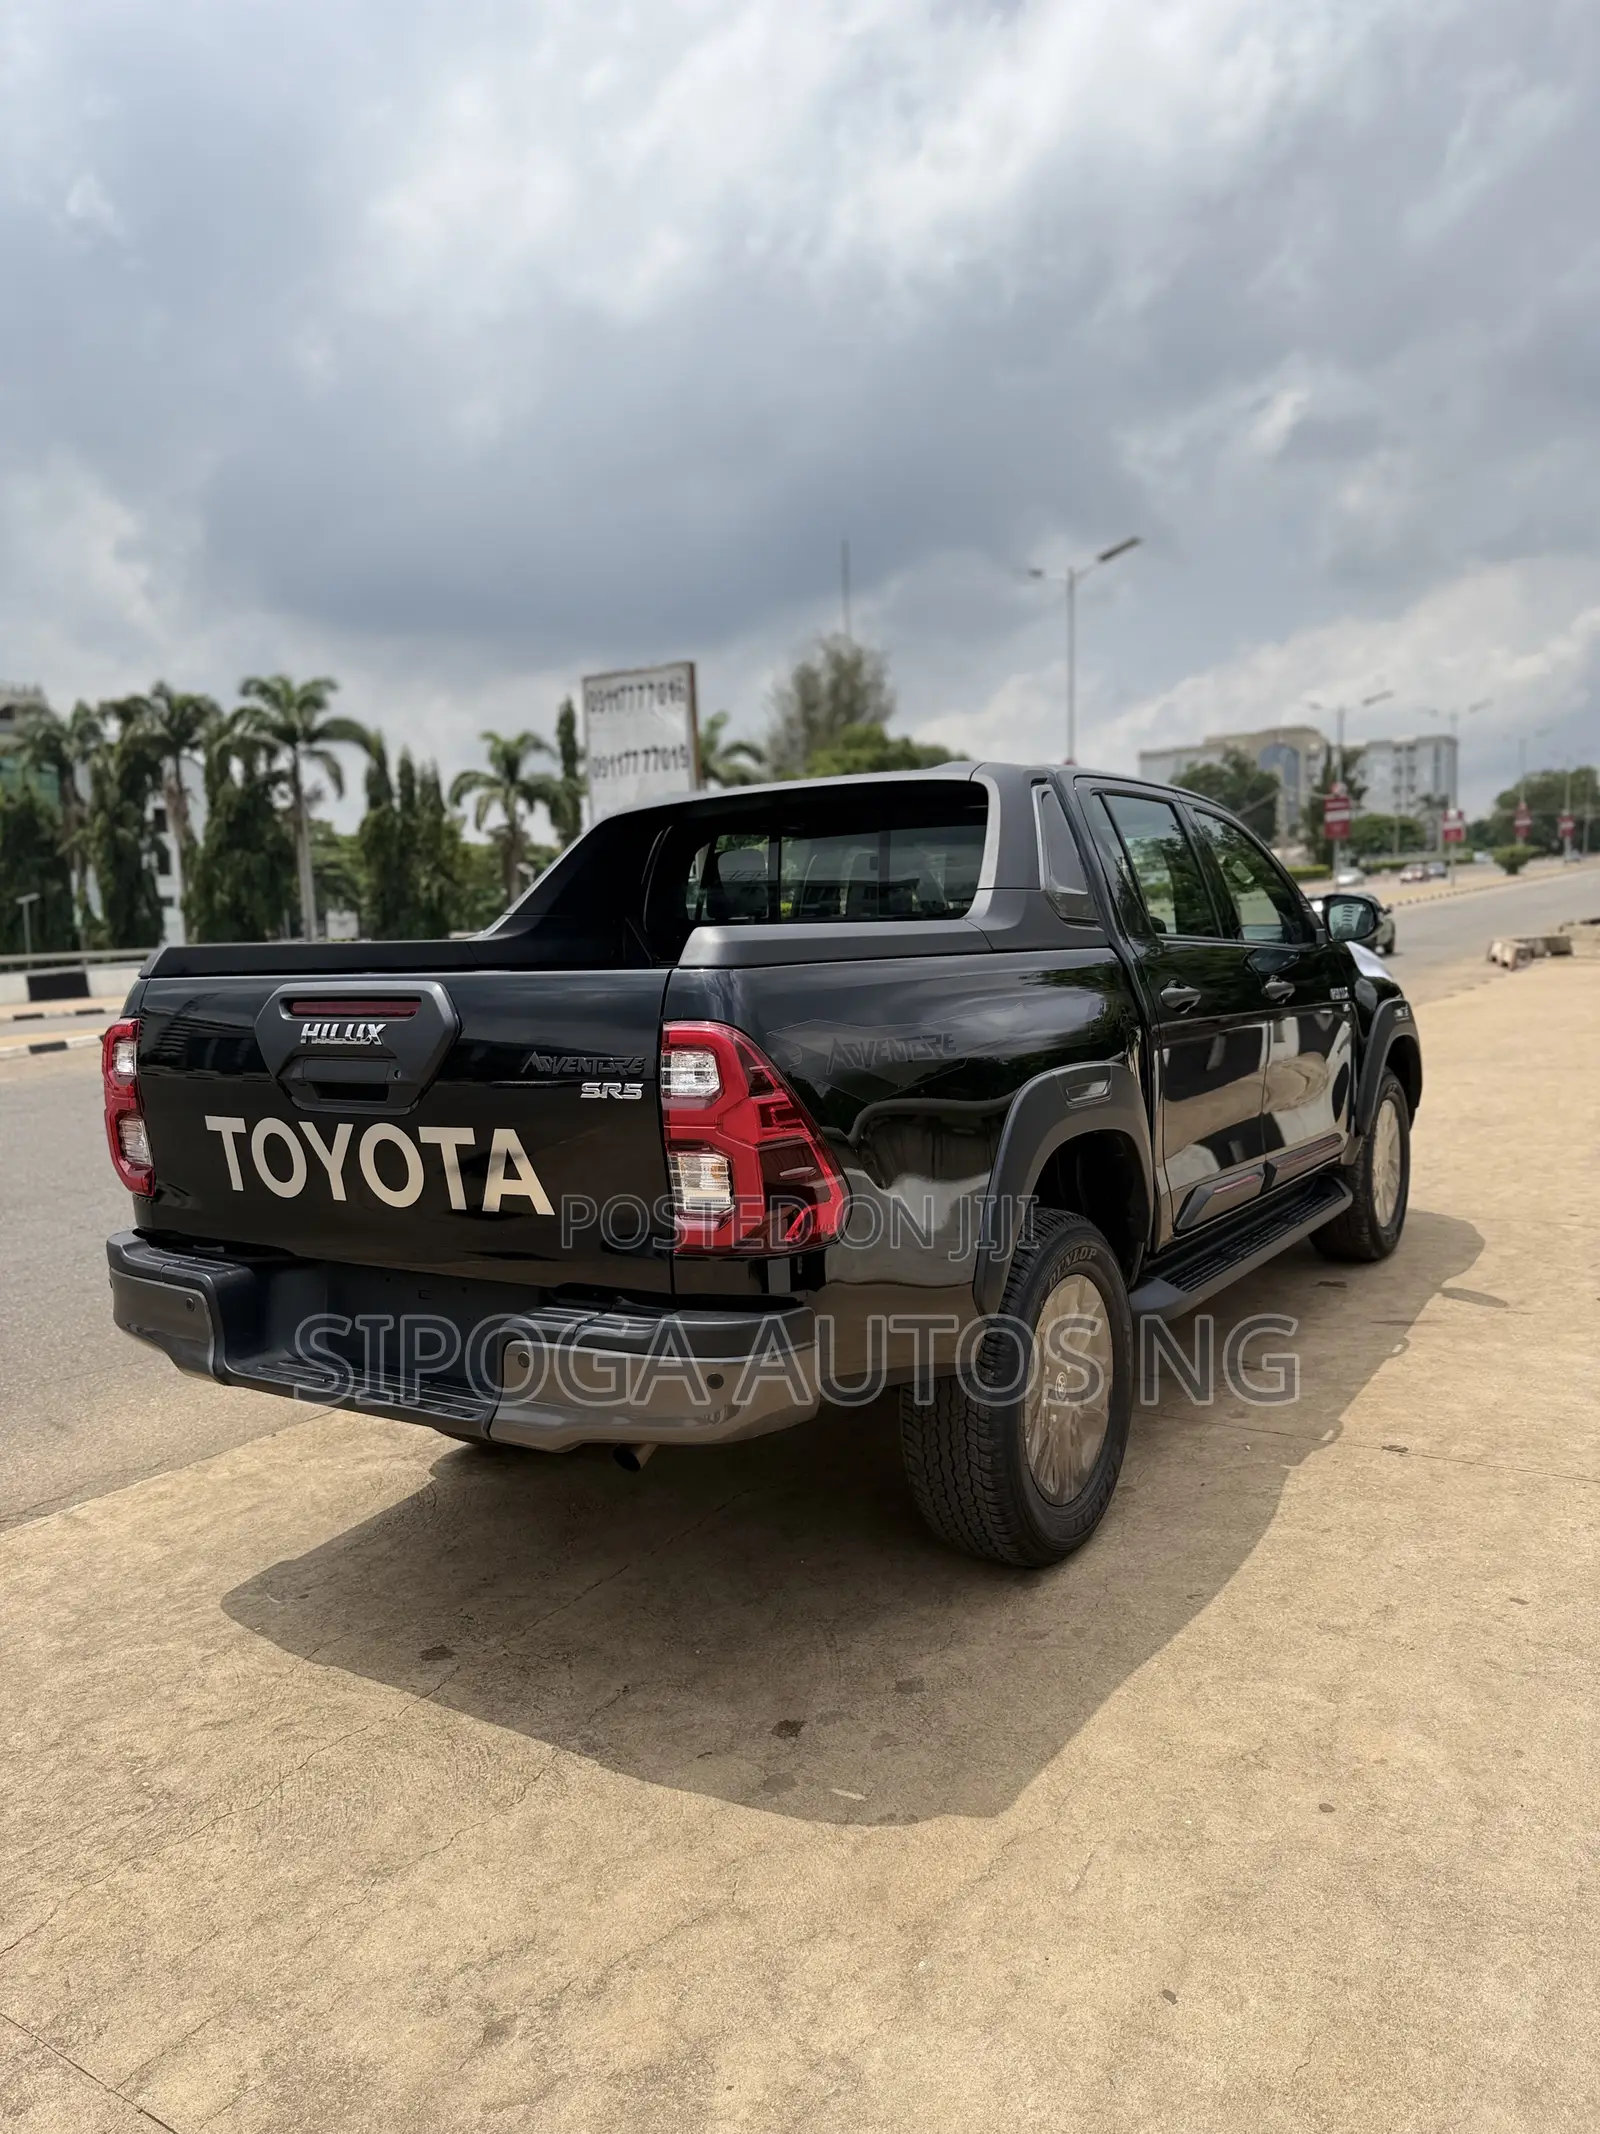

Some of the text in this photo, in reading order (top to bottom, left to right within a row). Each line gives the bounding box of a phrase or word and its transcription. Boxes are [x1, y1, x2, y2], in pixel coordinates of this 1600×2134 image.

[300, 1023, 386, 1045] HILUX
[580, 1082, 643, 1100] SR5
[205, 1114, 556, 1216] TOYOTA
